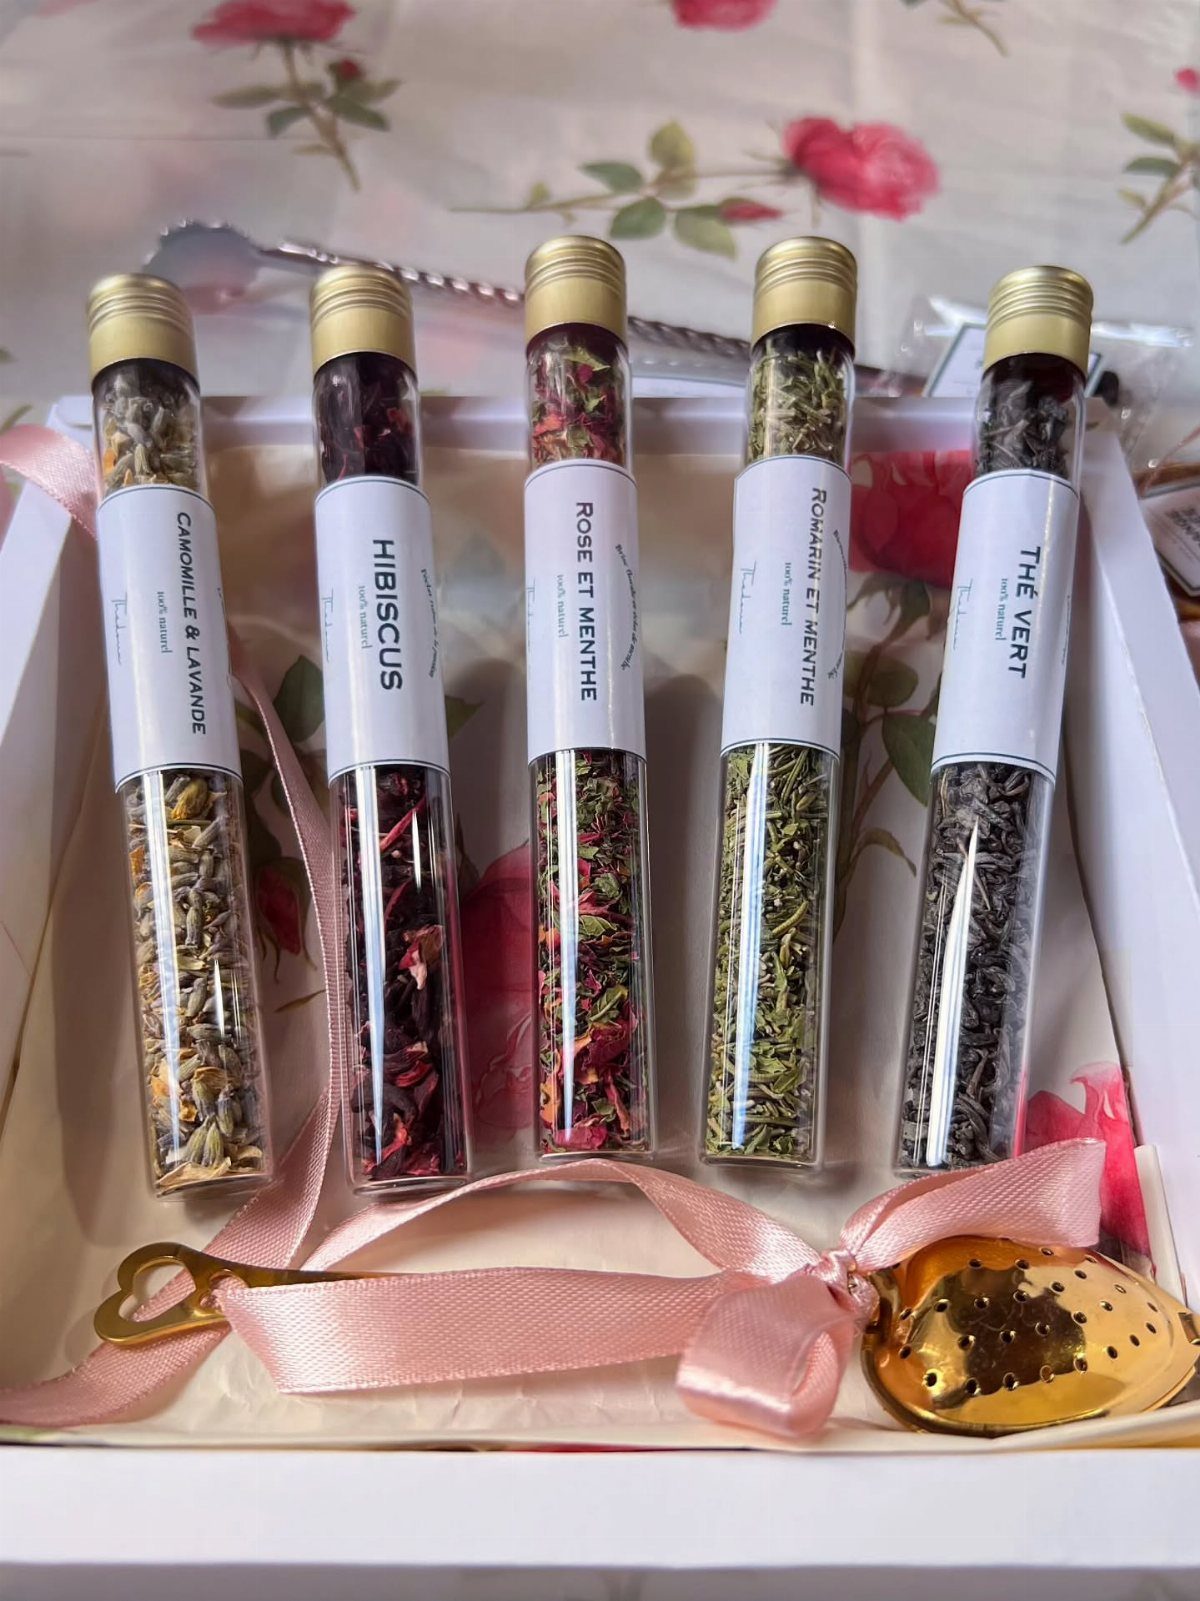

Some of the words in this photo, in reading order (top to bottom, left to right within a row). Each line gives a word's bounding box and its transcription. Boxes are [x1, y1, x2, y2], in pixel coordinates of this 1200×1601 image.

[576, 502, 593, 562] ROSE
[808, 488, 827, 581] ROMARIN
[177, 512, 197, 619] CAMOMILLE
[783, 562, 792, 586] 100%
[1016, 546, 1040, 599] THÉ
[157, 591, 168, 615] 100%
[358, 586, 369, 610] 100%
[557, 574, 566, 598] 100%
[577, 572, 593, 598] ET
[806, 587, 820, 615] ET
[998, 578, 1008, 602] 100%
[373, 539, 403, 690] HIBISCUS
[557, 601, 569, 638] naturel
[781, 589, 792, 626] naturel
[995, 604, 1006, 641] naturel
[158, 617, 172, 654] naturel
[185, 625, 200, 639] &
[360, 612, 372, 649] naturel
[1008, 610, 1032, 679] VERT
[578, 607, 597, 701] MENTHE
[800, 620, 818, 706] MENTHE
[186, 647, 206, 735] LAVANDE
